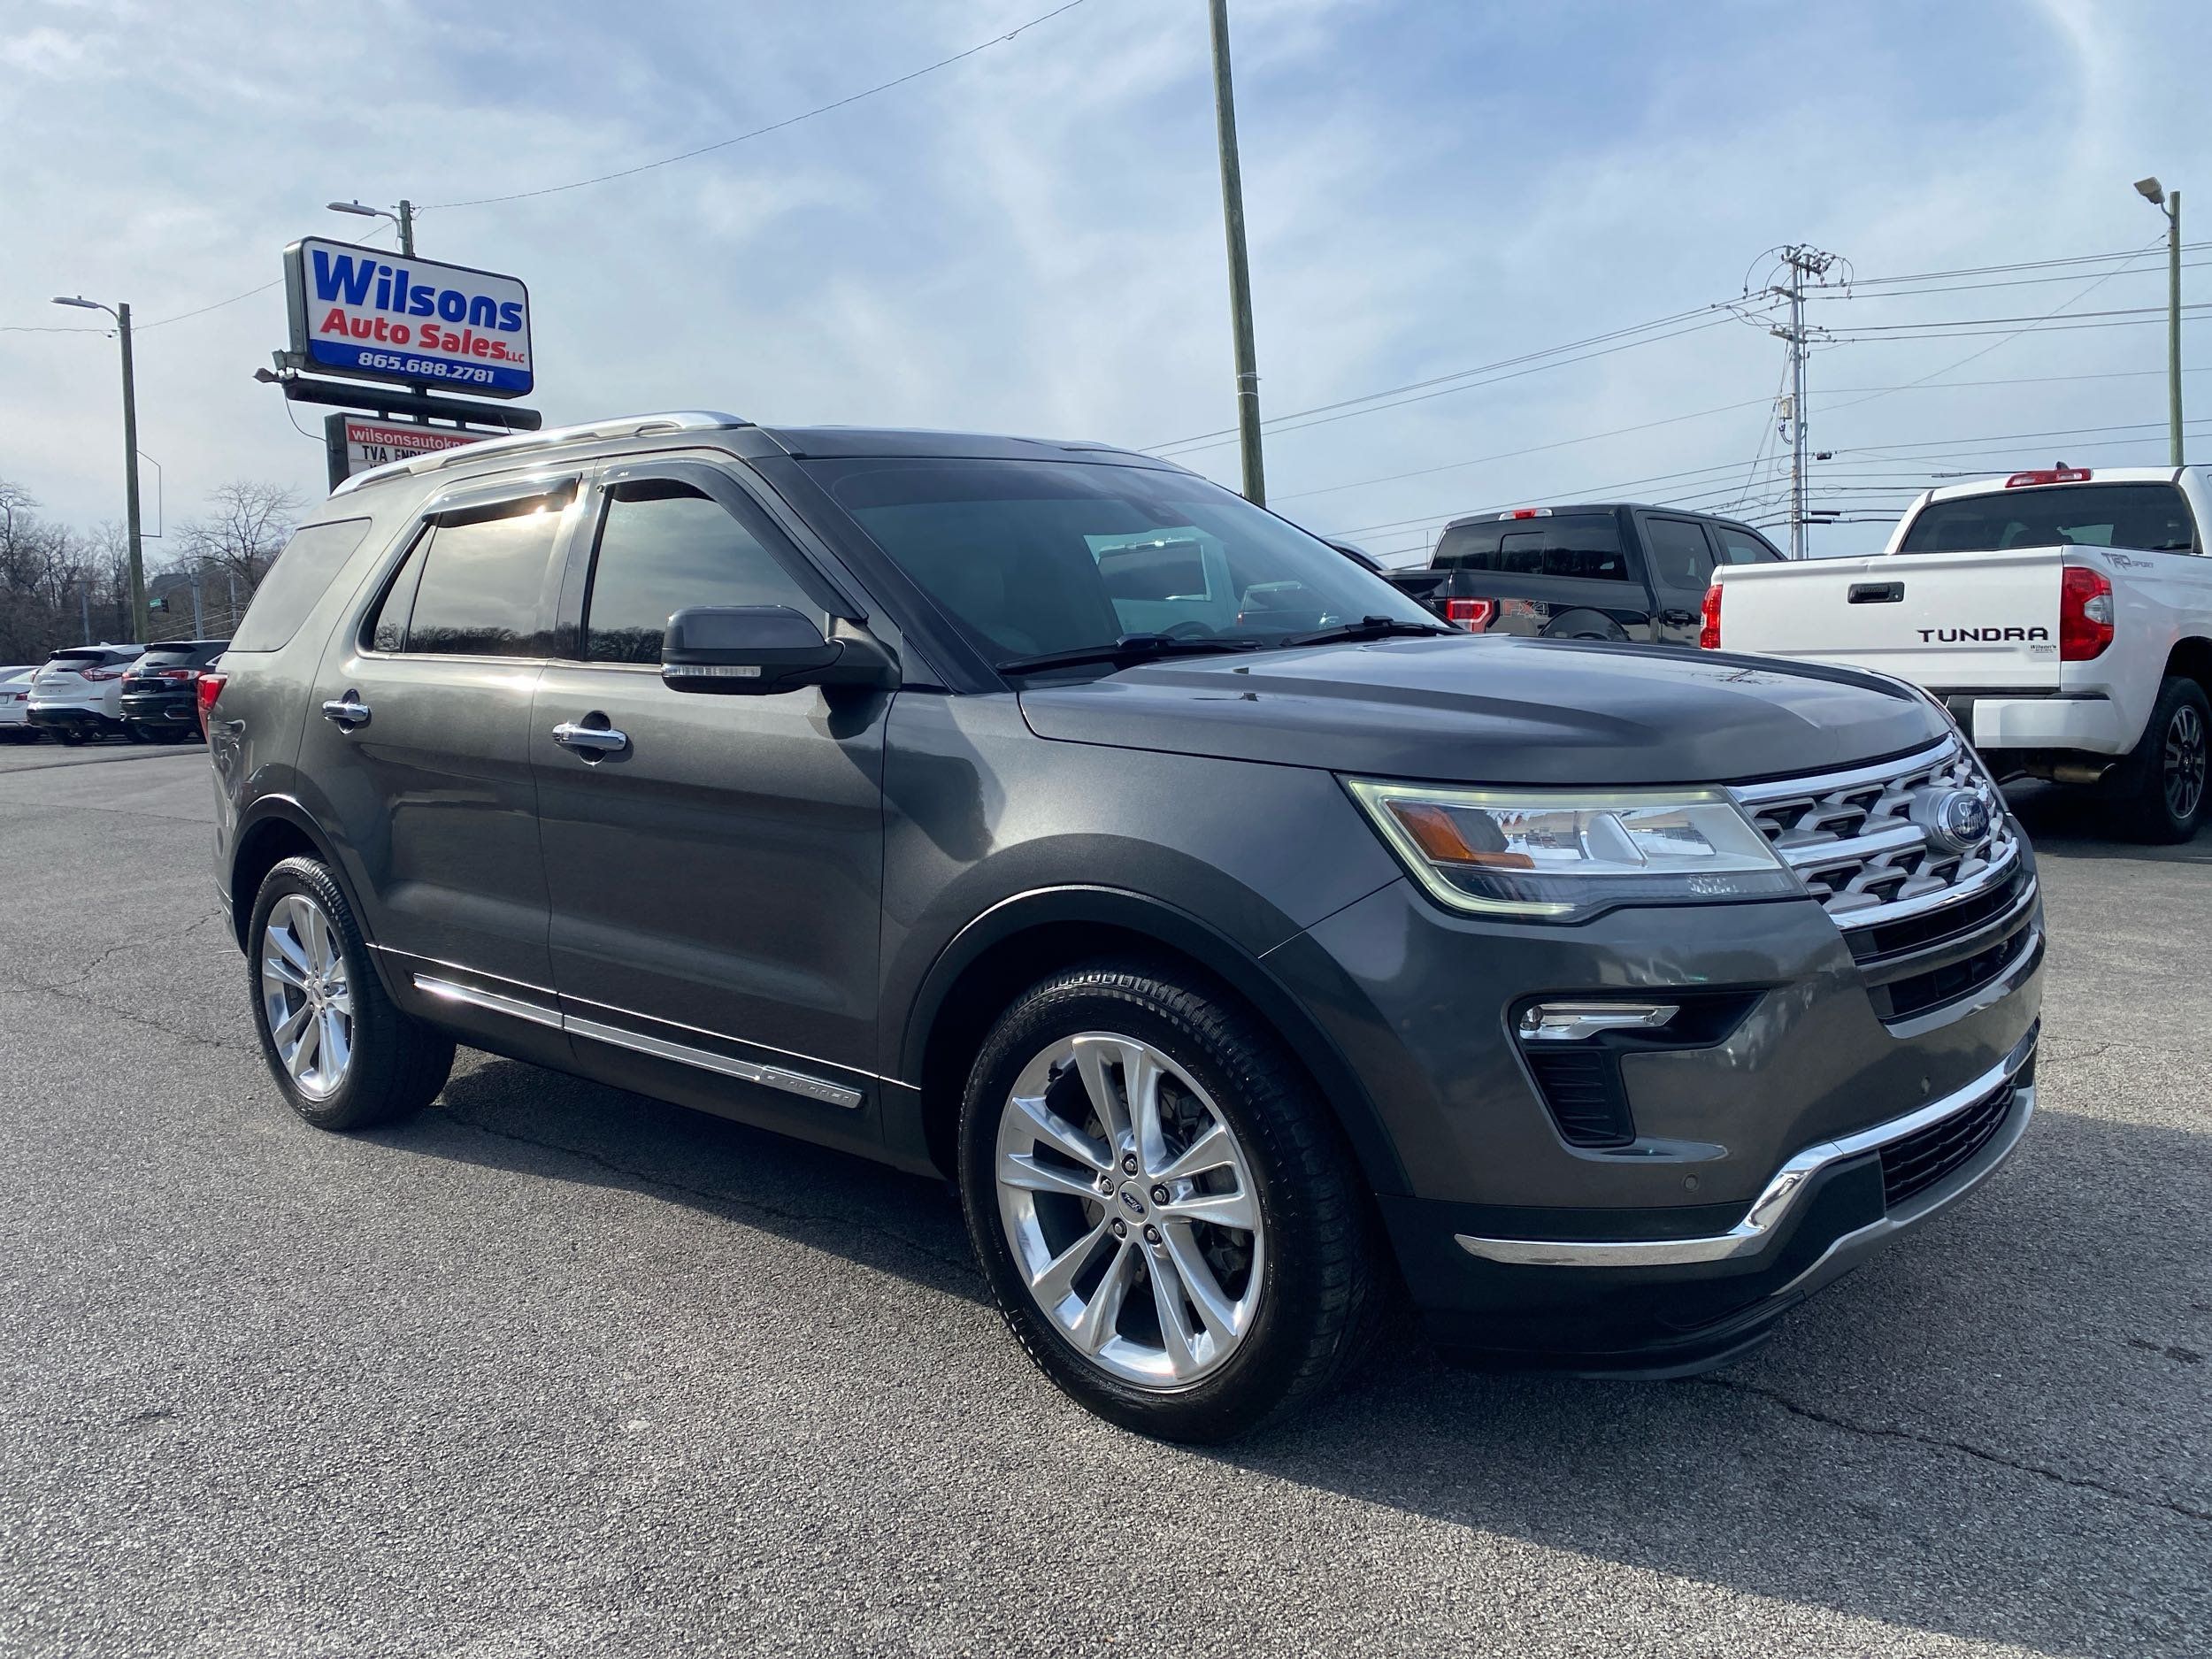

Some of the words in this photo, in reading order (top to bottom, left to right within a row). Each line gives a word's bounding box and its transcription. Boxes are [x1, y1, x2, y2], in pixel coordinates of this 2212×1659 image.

[311, 250, 523, 332] Wilsons
[319, 308, 411, 344] Auto
[418, 324, 506, 359] Sales
[505, 351, 525, 363] LLC
[358, 352, 494, 383] 865.688.2781
[362, 445, 388, 462] TVA
[1503, 599, 1548, 617] FX4
[1917, 627, 2048, 642] TUNDRA
